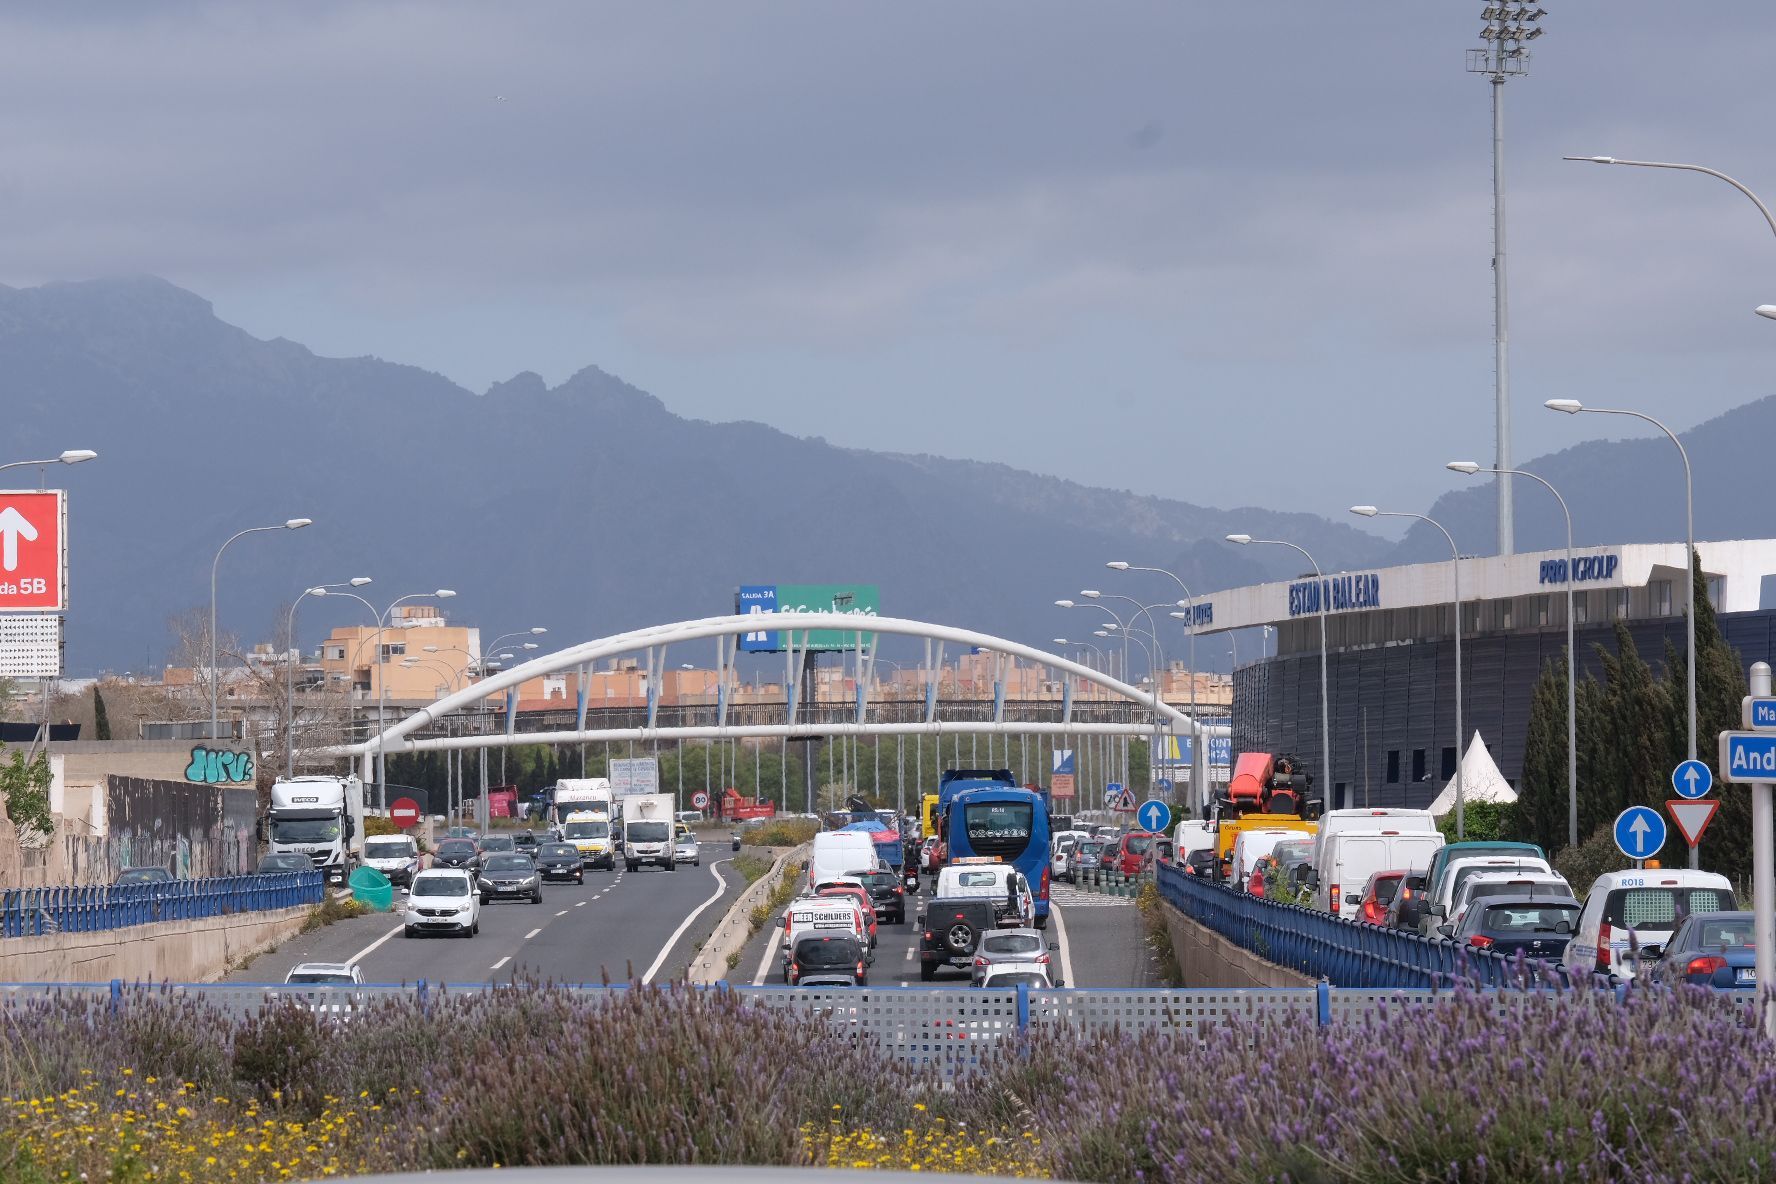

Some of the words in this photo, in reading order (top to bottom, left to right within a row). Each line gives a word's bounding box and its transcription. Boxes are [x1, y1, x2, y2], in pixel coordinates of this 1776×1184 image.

[20, 577, 47, 595] 5B
[763, 590, 775, 598] 3A
[1289, 579, 1331, 616] ESTADO
[1332, 573, 1380, 610] BALEAR
[1732, 744, 1776, 771] And
[695, 796, 706, 804] 80
[814, 912, 851, 921] SCHILDERS
